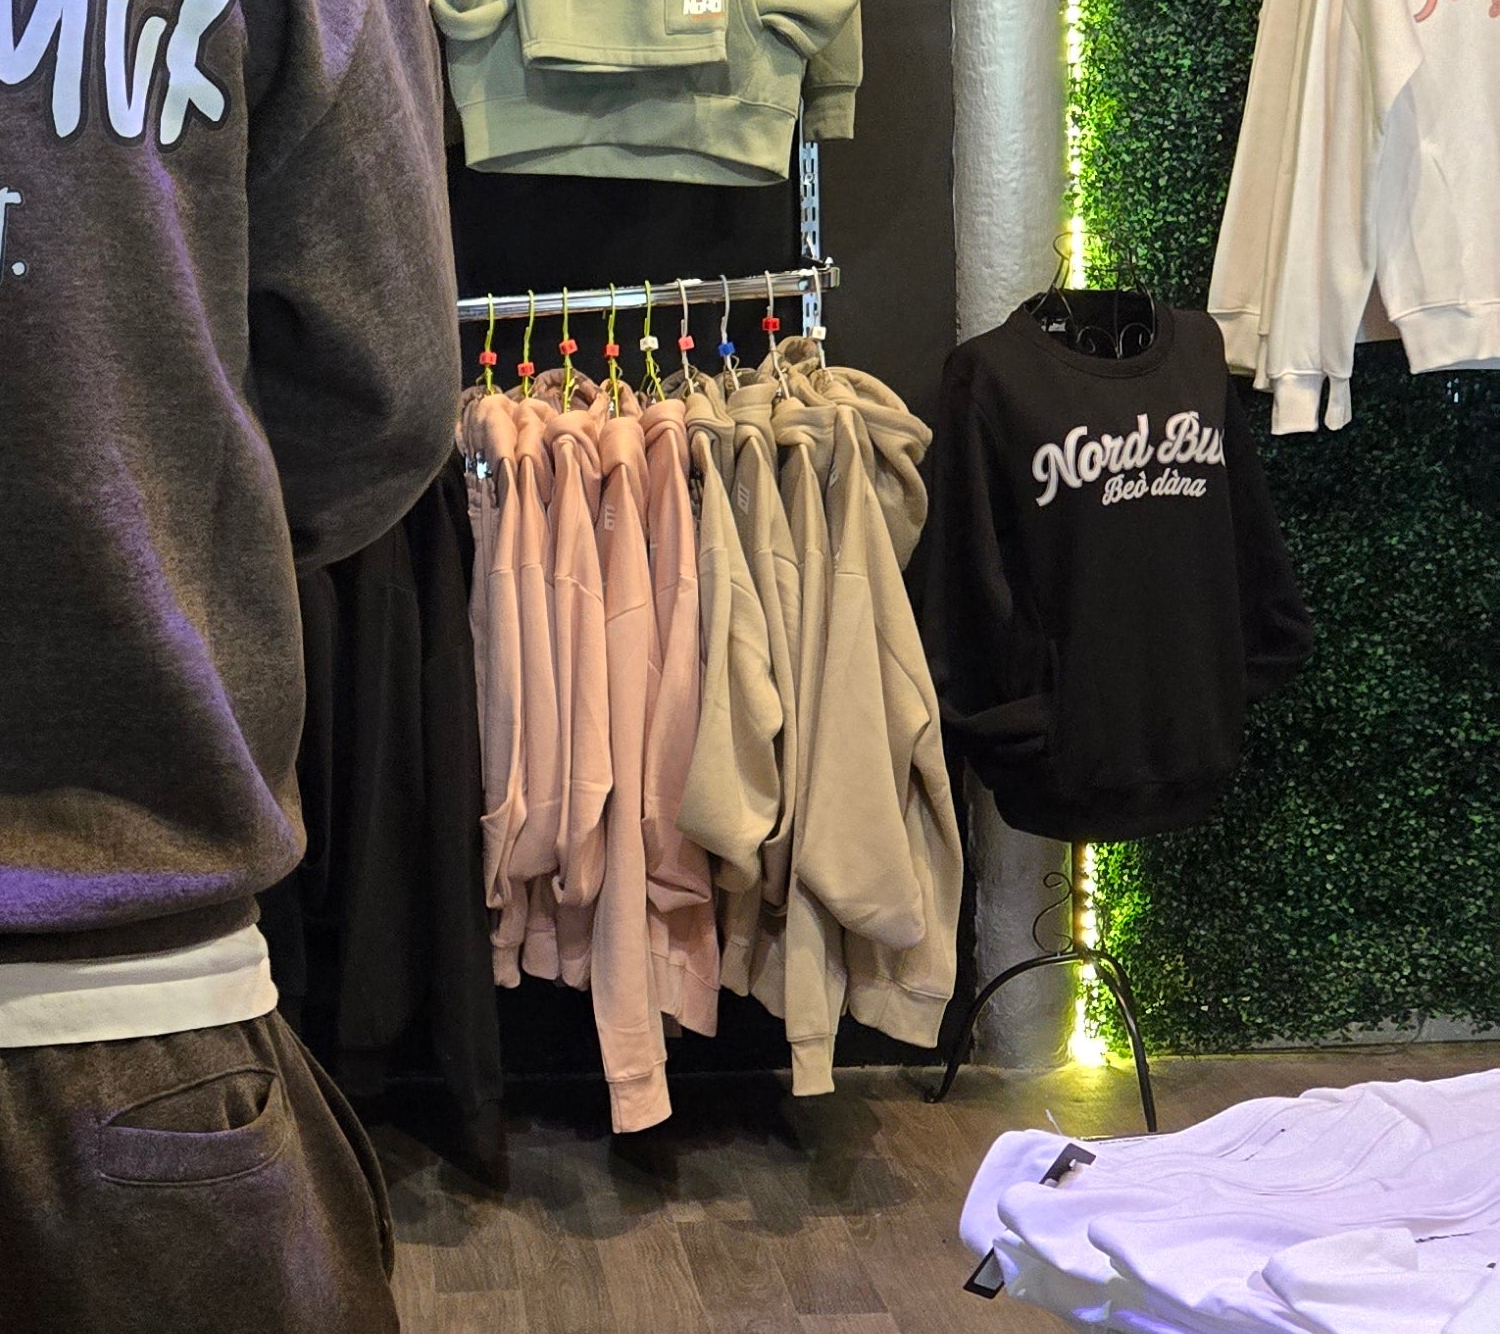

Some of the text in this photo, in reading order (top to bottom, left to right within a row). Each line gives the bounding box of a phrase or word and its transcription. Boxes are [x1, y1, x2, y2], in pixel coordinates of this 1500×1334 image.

[1032, 410, 1226, 507] Nord Bu
[1102, 467, 1207, 506] Beò dàna
